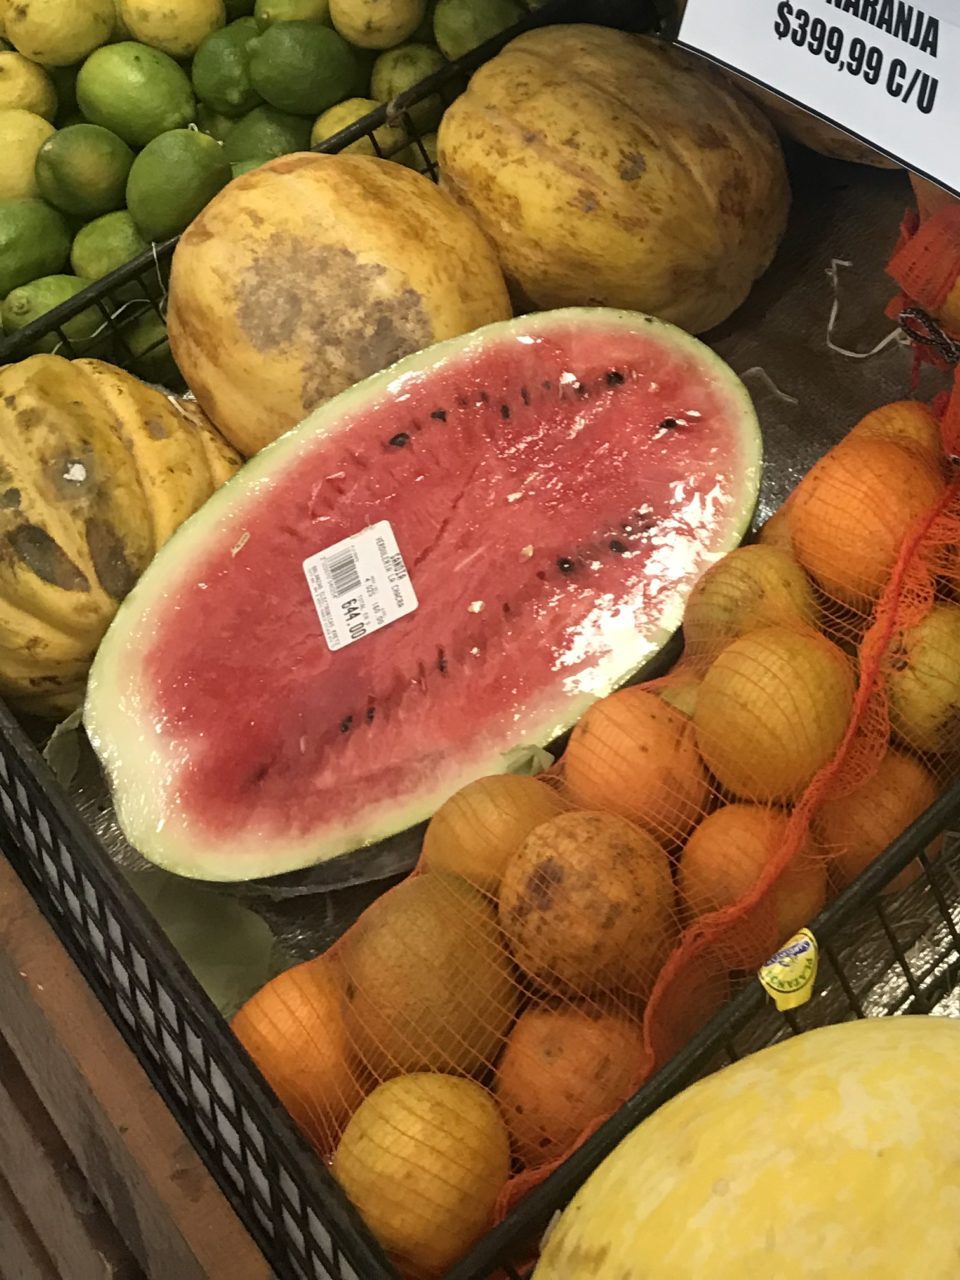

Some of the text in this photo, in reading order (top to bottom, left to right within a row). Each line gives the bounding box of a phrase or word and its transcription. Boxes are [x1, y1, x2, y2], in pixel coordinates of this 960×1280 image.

[774, 0, 938, 114] $399,99 C/U
[341, 598, 367, 640] 644.00
